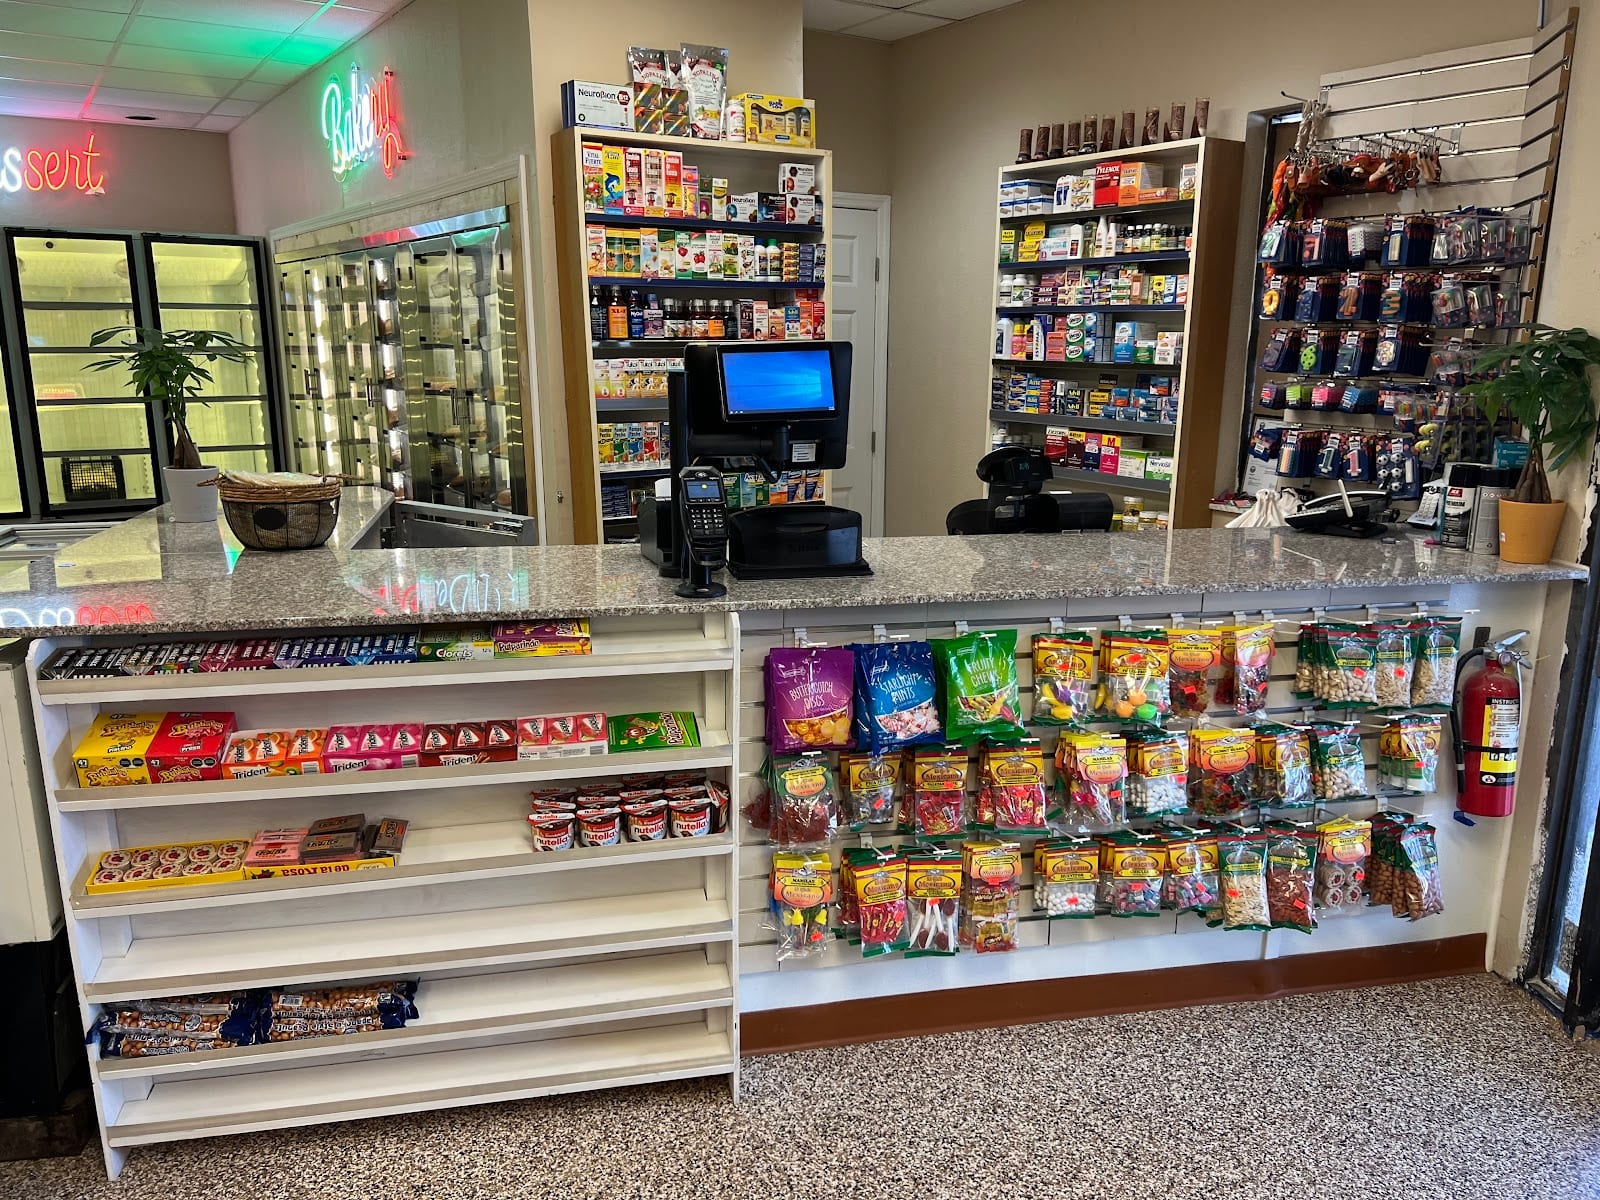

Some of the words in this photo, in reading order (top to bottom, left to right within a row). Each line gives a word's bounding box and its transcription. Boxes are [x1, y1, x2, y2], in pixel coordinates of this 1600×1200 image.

[321, 62, 404, 181] Bakery
[0, 134, 104, 193] ssert
[1096, 165, 1120, 174] TYLENOL
[498, 638, 540, 653] Pulparindo
[436, 649, 473, 658] Clorets
[966, 657, 995, 674] FRUITY
[880, 673, 917, 694] STARLIGHT
[789, 681, 834, 702] BUTTERSCOTCH
[804, 694, 825, 710] DISCS
[101, 721, 155, 735] Bubbaloo
[171, 720, 224, 735] Bubbaloo
[660, 712, 684, 746] Pulparindo
[331, 759, 369, 773] Trident
[441, 754, 477, 766] Trident
[232, 766, 271, 780] Trident
[634, 822, 664, 833] nutella
[676, 820, 706, 830] nutella
[536, 835, 568, 846] nutella
[583, 830, 615, 841] nutella
[1056, 865, 1089, 873] Mexicano
